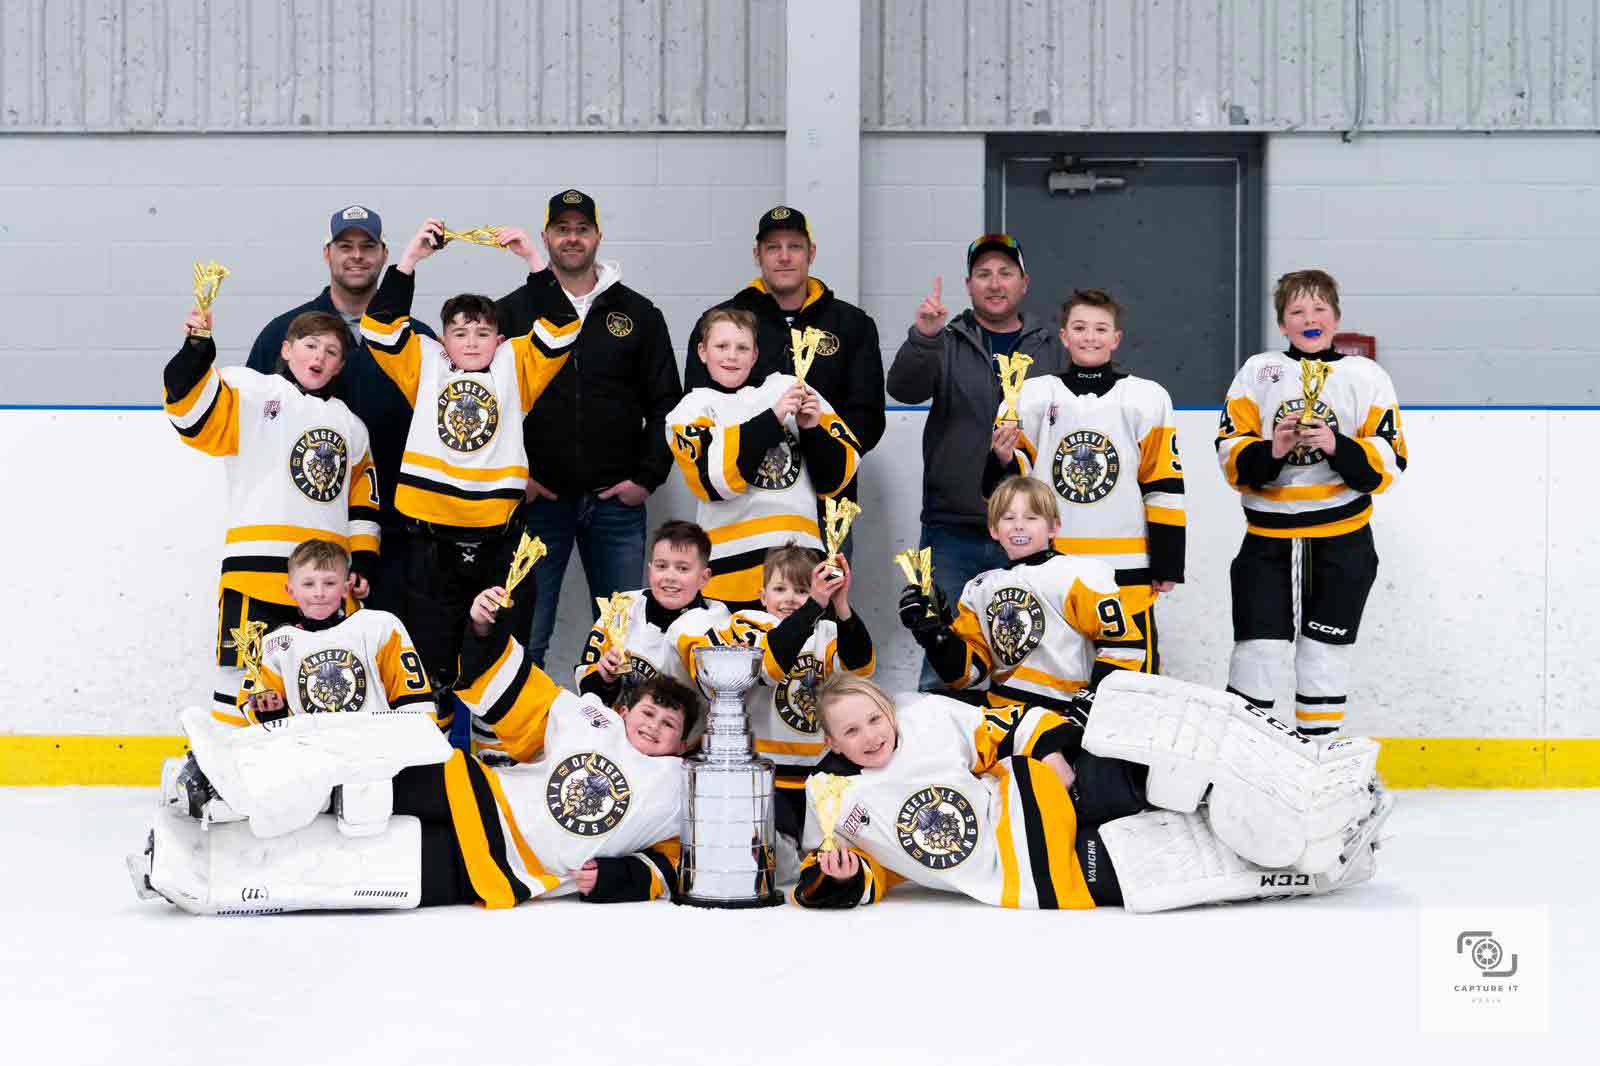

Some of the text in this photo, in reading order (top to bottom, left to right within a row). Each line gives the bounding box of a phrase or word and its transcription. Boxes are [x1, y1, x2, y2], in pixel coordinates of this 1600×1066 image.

[1374, 408, 1398, 447] 4
[753, 465, 799, 489] IKINGS
[1096, 597, 1127, 639] 9
[1307, 620, 1348, 636] CCM
[581, 628, 606, 664] 6
[400, 650, 427, 690] 9
[1244, 703, 1312, 744] CCM
[1087, 839, 1097, 883] VAUGHN
[1260, 873, 1310, 888] CCM
